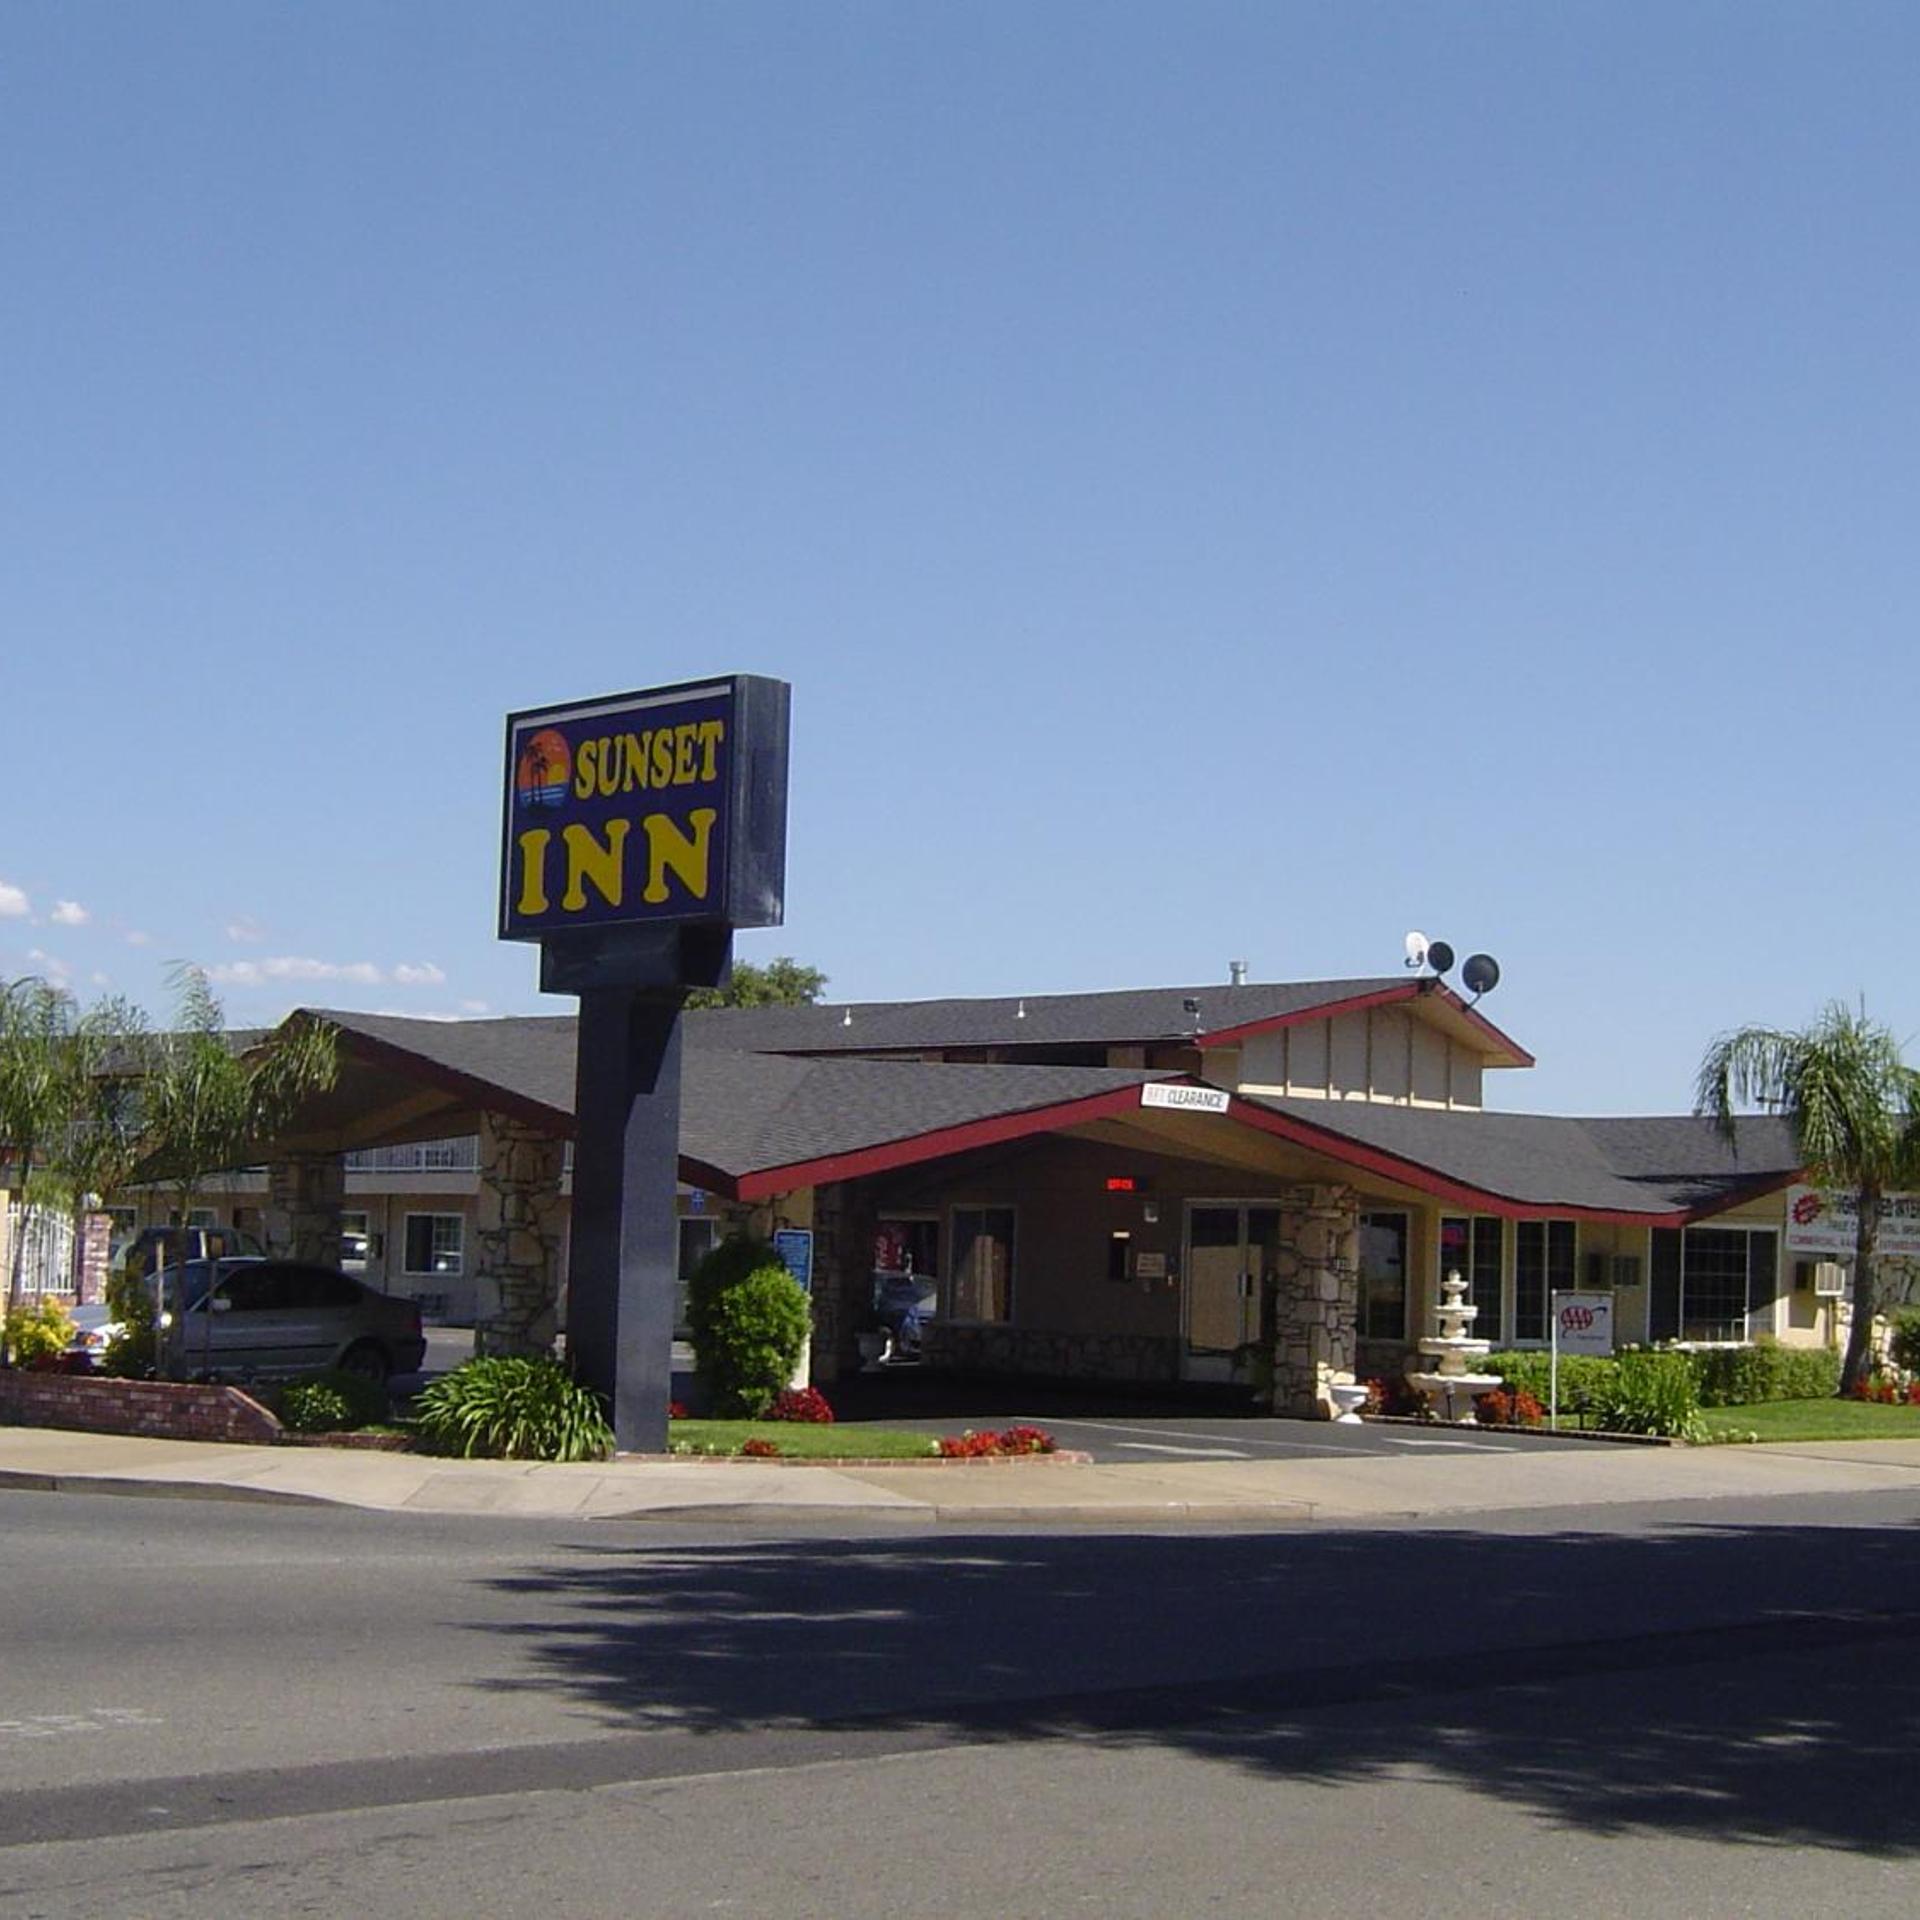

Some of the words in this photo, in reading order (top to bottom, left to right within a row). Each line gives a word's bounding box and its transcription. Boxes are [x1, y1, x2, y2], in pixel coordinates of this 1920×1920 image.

[575, 720, 724, 800] SUNSET
[517, 808, 717, 915] INN
[1168, 1089, 1224, 1109] CLEARANCE
[1562, 1307, 1591, 1329] AAA
